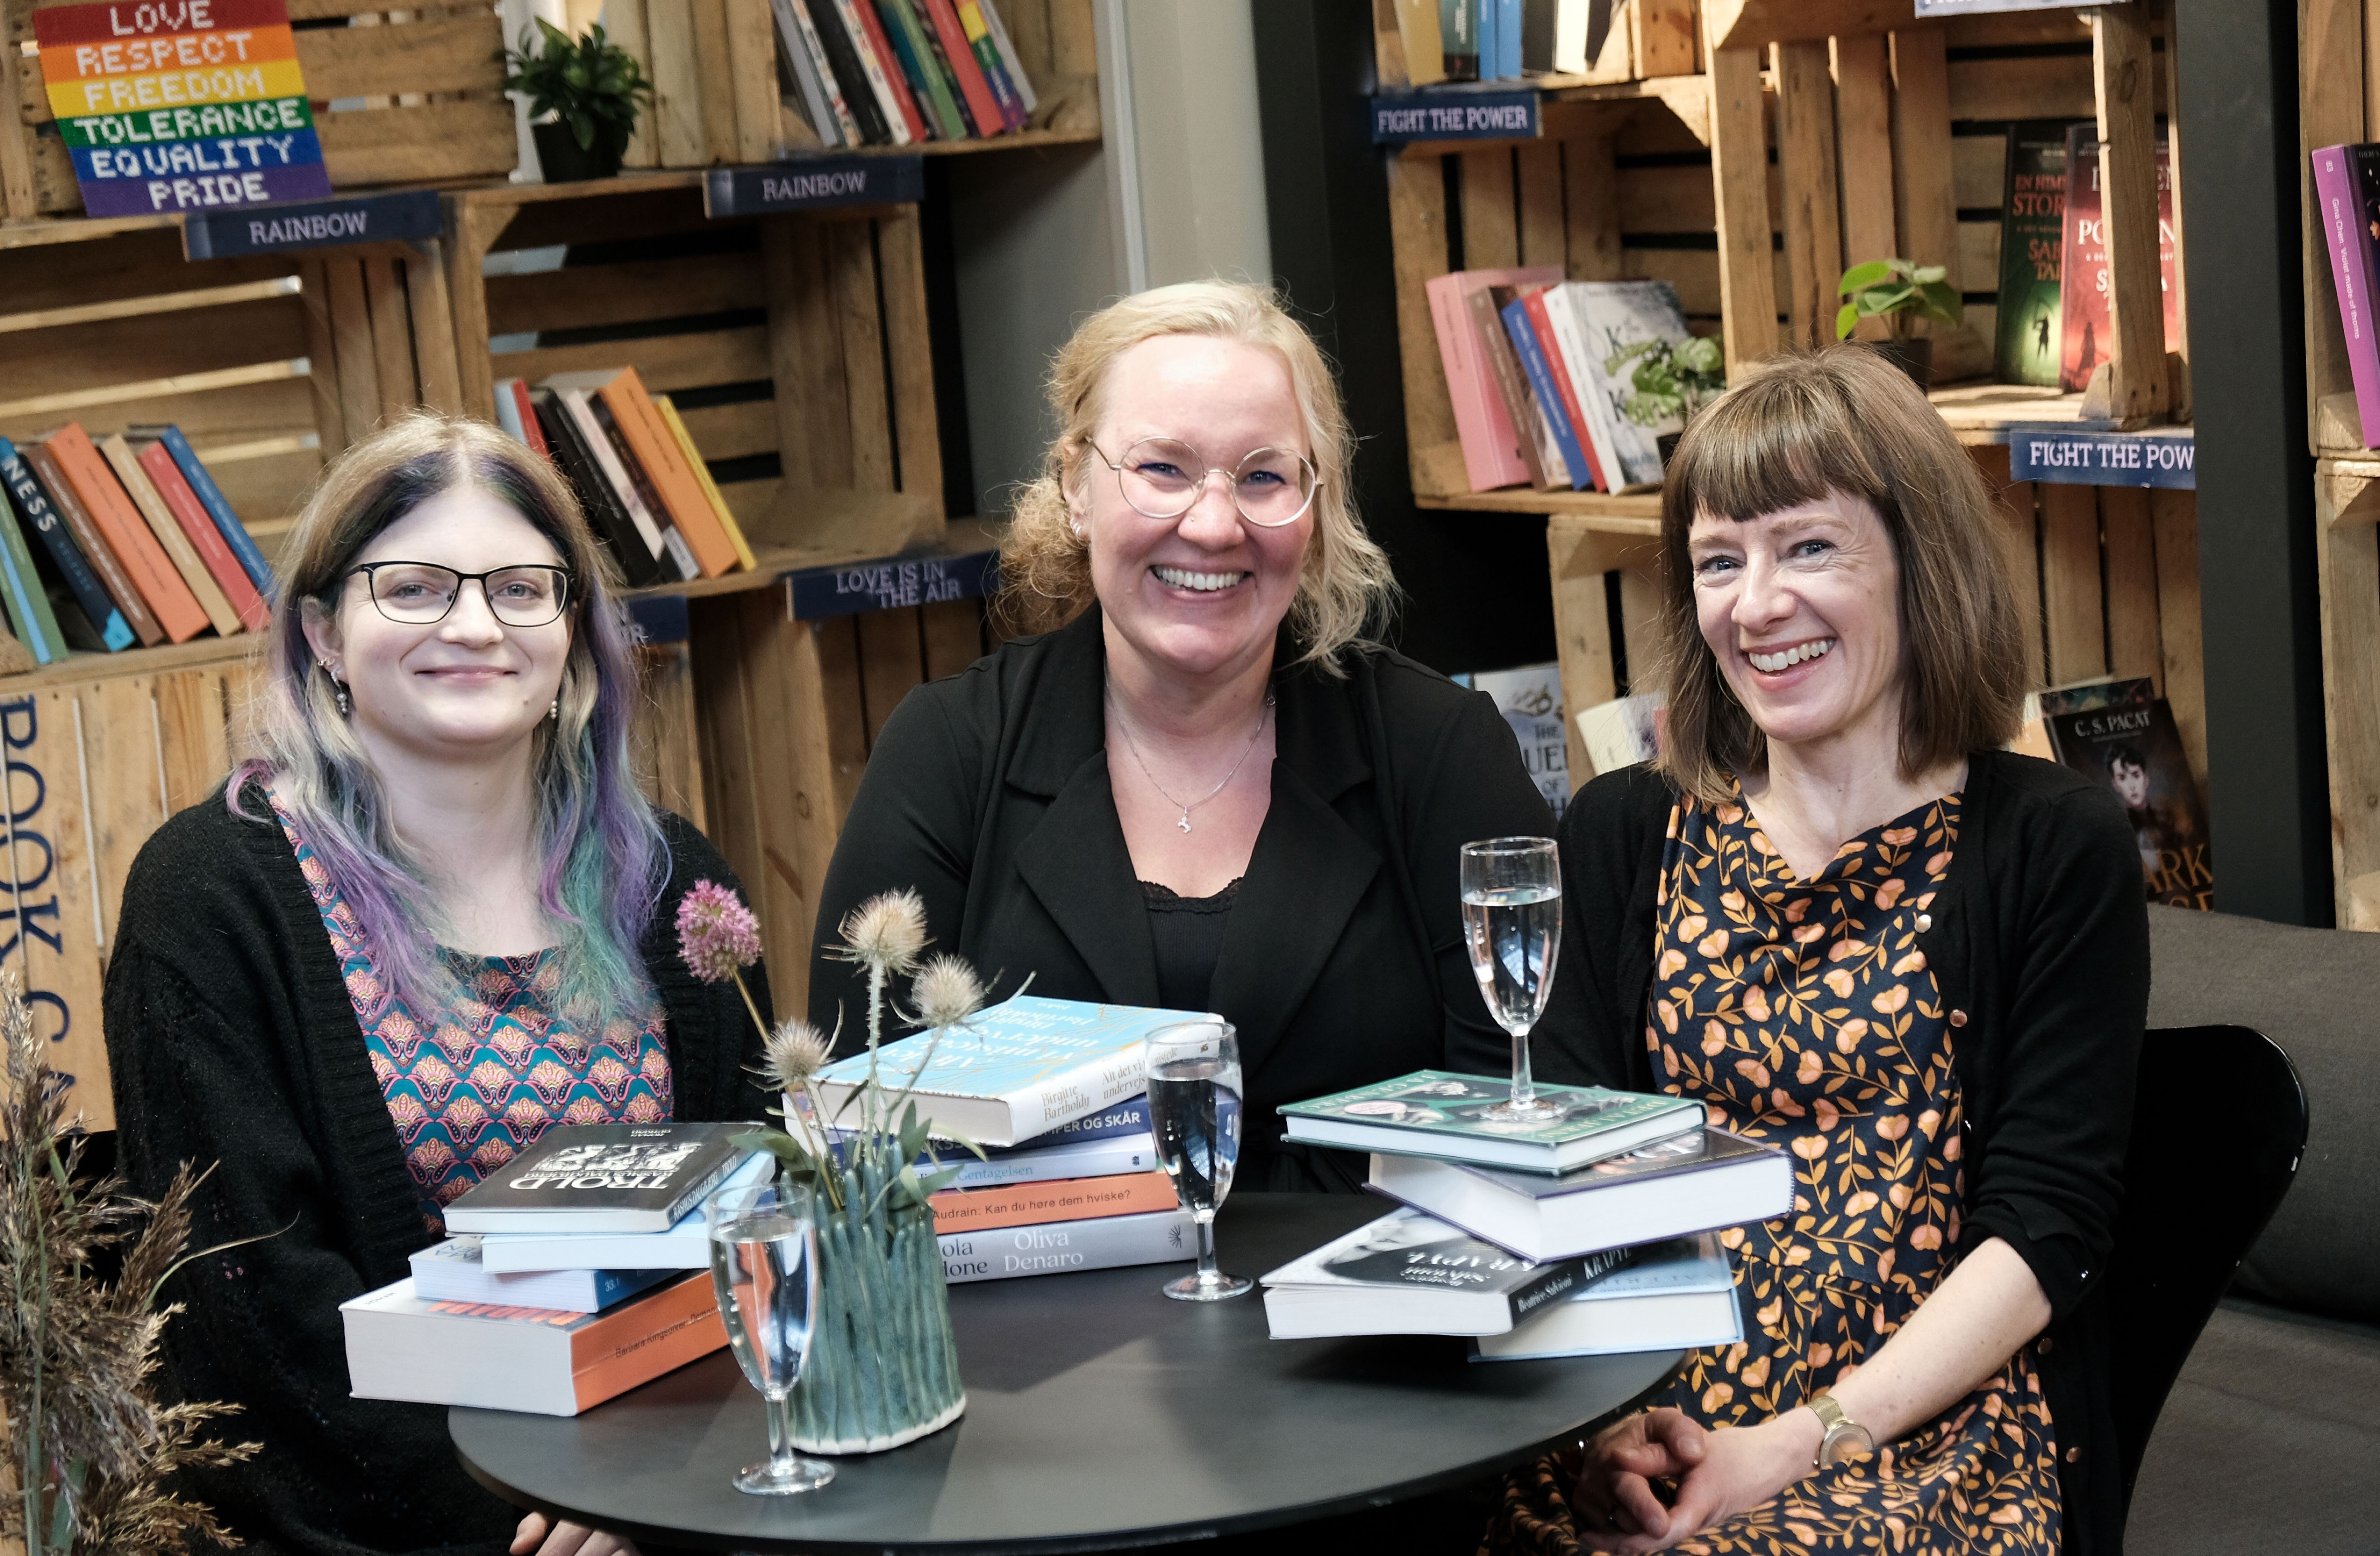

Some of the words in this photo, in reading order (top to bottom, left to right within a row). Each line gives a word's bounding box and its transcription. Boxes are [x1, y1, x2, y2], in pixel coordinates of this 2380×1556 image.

[110, 0, 214, 36] LOVE
[75, 32, 252, 76] RESPECT
[83, 68, 265, 111] FREEDOM
[74, 98, 305, 144] TOLERANCE
[1378, 108, 1427, 133] FIGHT
[1428, 107, 1465, 131] THE
[1466, 105, 1529, 131] POWER
[91, 135, 294, 178] EQUALITY
[148, 172, 270, 210] PRIDE
[761, 170, 867, 202] RAINBOW
[2332, 197, 2340, 220] Gina
[249, 210, 368, 244] RAINBOW
[2030, 441, 2093, 467] FIGHT
[2097, 443, 2141, 469] THE
[2145, 445, 2195, 470] POW
[2, 457, 58, 532] NESS
[835, 566, 891, 595] LOVE
[898, 563, 917, 583] IS
[923, 561, 945, 582] IN
[875, 586, 920, 609] THE
[925, 579, 962, 603] AIR
[2075, 720, 2090, 737] C.
[2091, 717, 2106, 734] S.
[1102, 1070, 1116, 1086] Alt
[1118, 1063, 1132, 1081] det
[1103, 1075, 1146, 1100] undervejs
[1041, 1084, 1078, 1108] Birgitte
[1044, 1096, 1090, 1122] Bartholdy
[1083, 1117, 1102, 1130] OG
[1104, 1111, 1141, 1127] SKÅR
[509, 1176, 669, 1190] TROLD
[673, 1194, 692, 1222] RASMUS
[722, 1155, 737, 1178] TROLD
[958, 1165, 1033, 1183] Gentagelsen
[933, 1207, 981, 1221] Audrain:
[985, 1203, 1008, 1215] Kan
[1011, 1199, 1025, 1212] du
[1058, 1195, 1083, 1206] dem
[1086, 1190, 1130, 1204] hviske?
[1014, 1229, 1069, 1251] Oliva
[1004, 1250, 1083, 1273] Denaro
